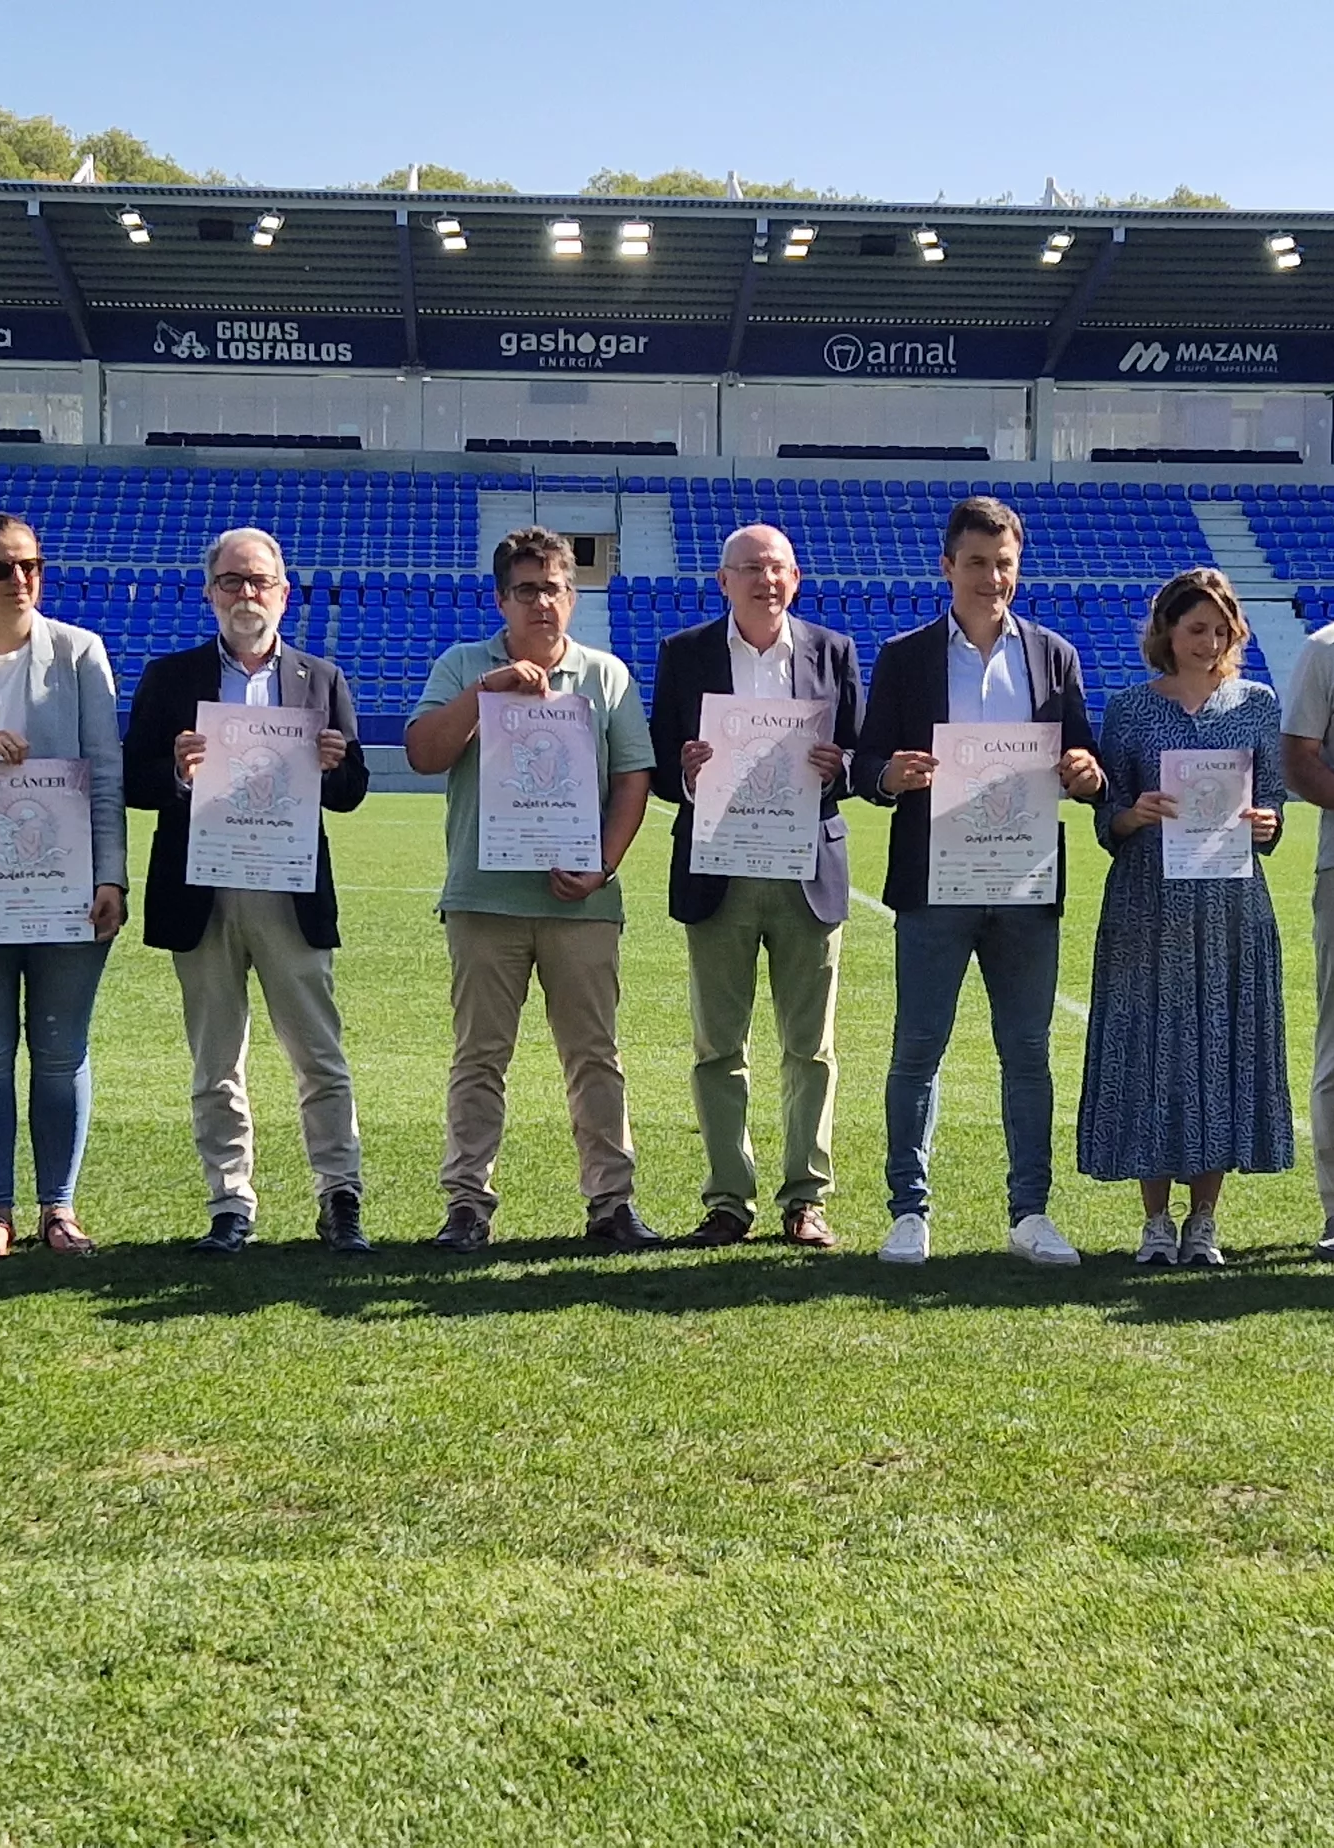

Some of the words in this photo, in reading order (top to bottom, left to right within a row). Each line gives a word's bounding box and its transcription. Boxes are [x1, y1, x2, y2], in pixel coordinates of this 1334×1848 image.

[216, 321, 299, 340] GRUAS
[216, 341, 353, 362] LOSFABLOS
[867, 334, 957, 365] arnal
[1175, 342, 1279, 362] MAZANA
